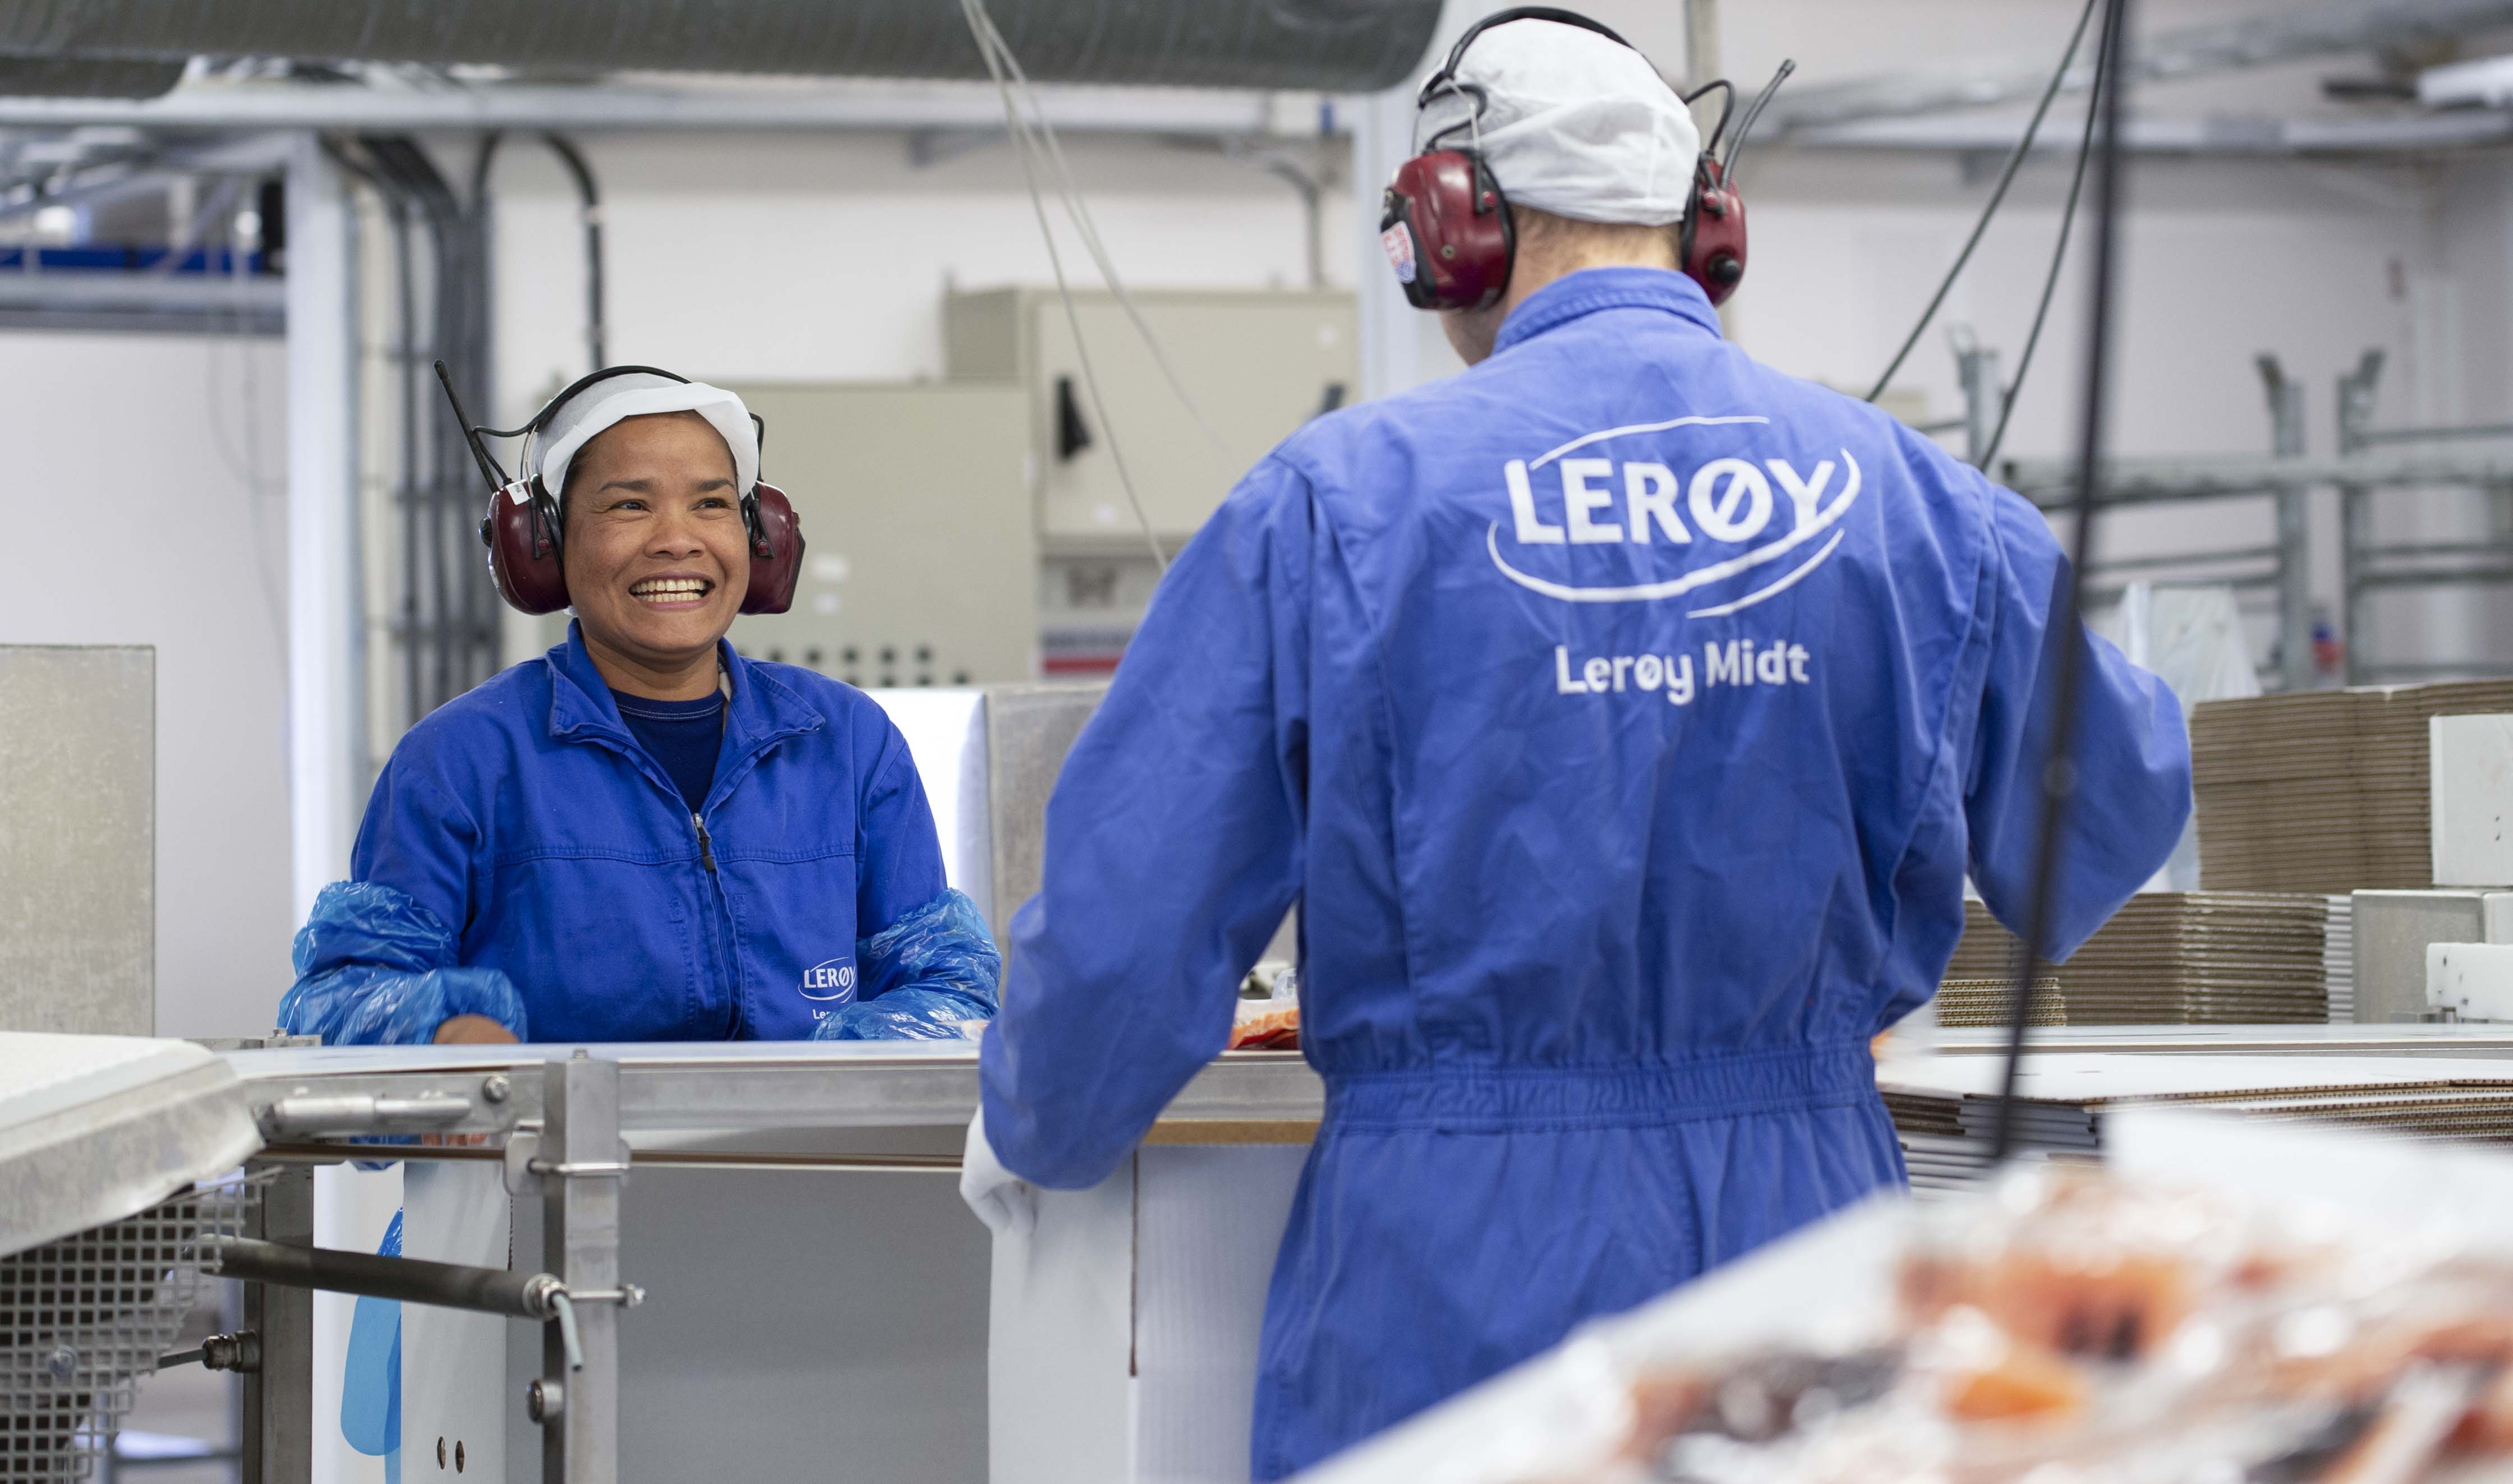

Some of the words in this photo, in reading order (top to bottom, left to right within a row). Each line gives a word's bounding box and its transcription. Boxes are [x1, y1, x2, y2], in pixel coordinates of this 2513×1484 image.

[1504, 458, 1835, 543] LERØY
[1555, 646, 1694, 705] Lerøy
[1705, 639, 1810, 686] Midt
[804, 966, 855, 988] LERØY
